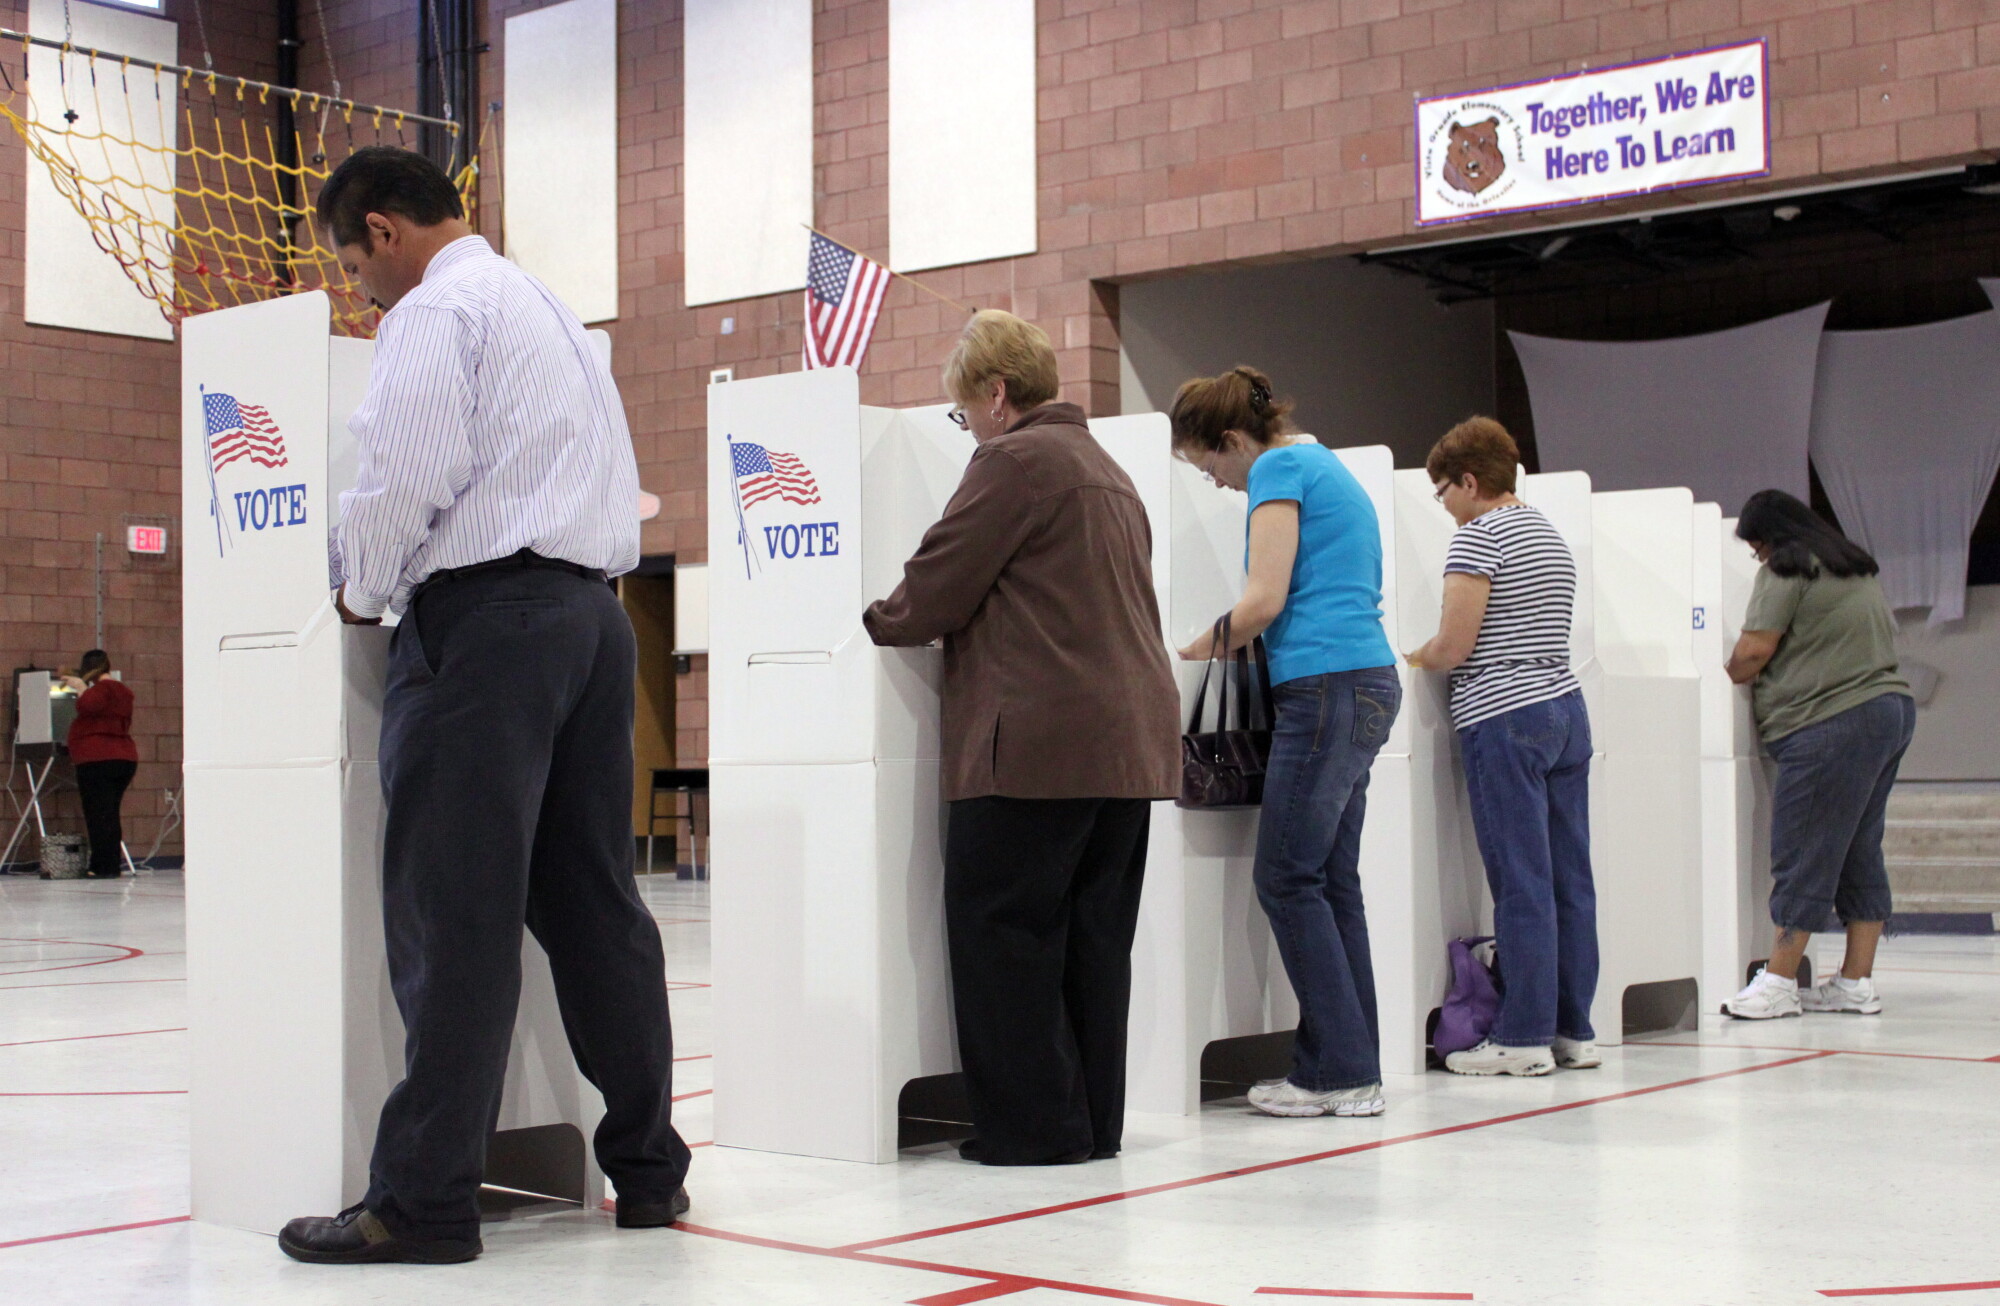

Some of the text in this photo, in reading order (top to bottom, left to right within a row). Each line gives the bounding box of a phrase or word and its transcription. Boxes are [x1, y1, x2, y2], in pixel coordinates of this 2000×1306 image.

[1526, 71, 1755, 138] Together, We Are
[1545, 126, 1735, 180] Here To Learn
[234, 483, 306, 532] VOTE
[135, 527, 163, 551] EXIT
[763, 521, 839, 559] VOTE
